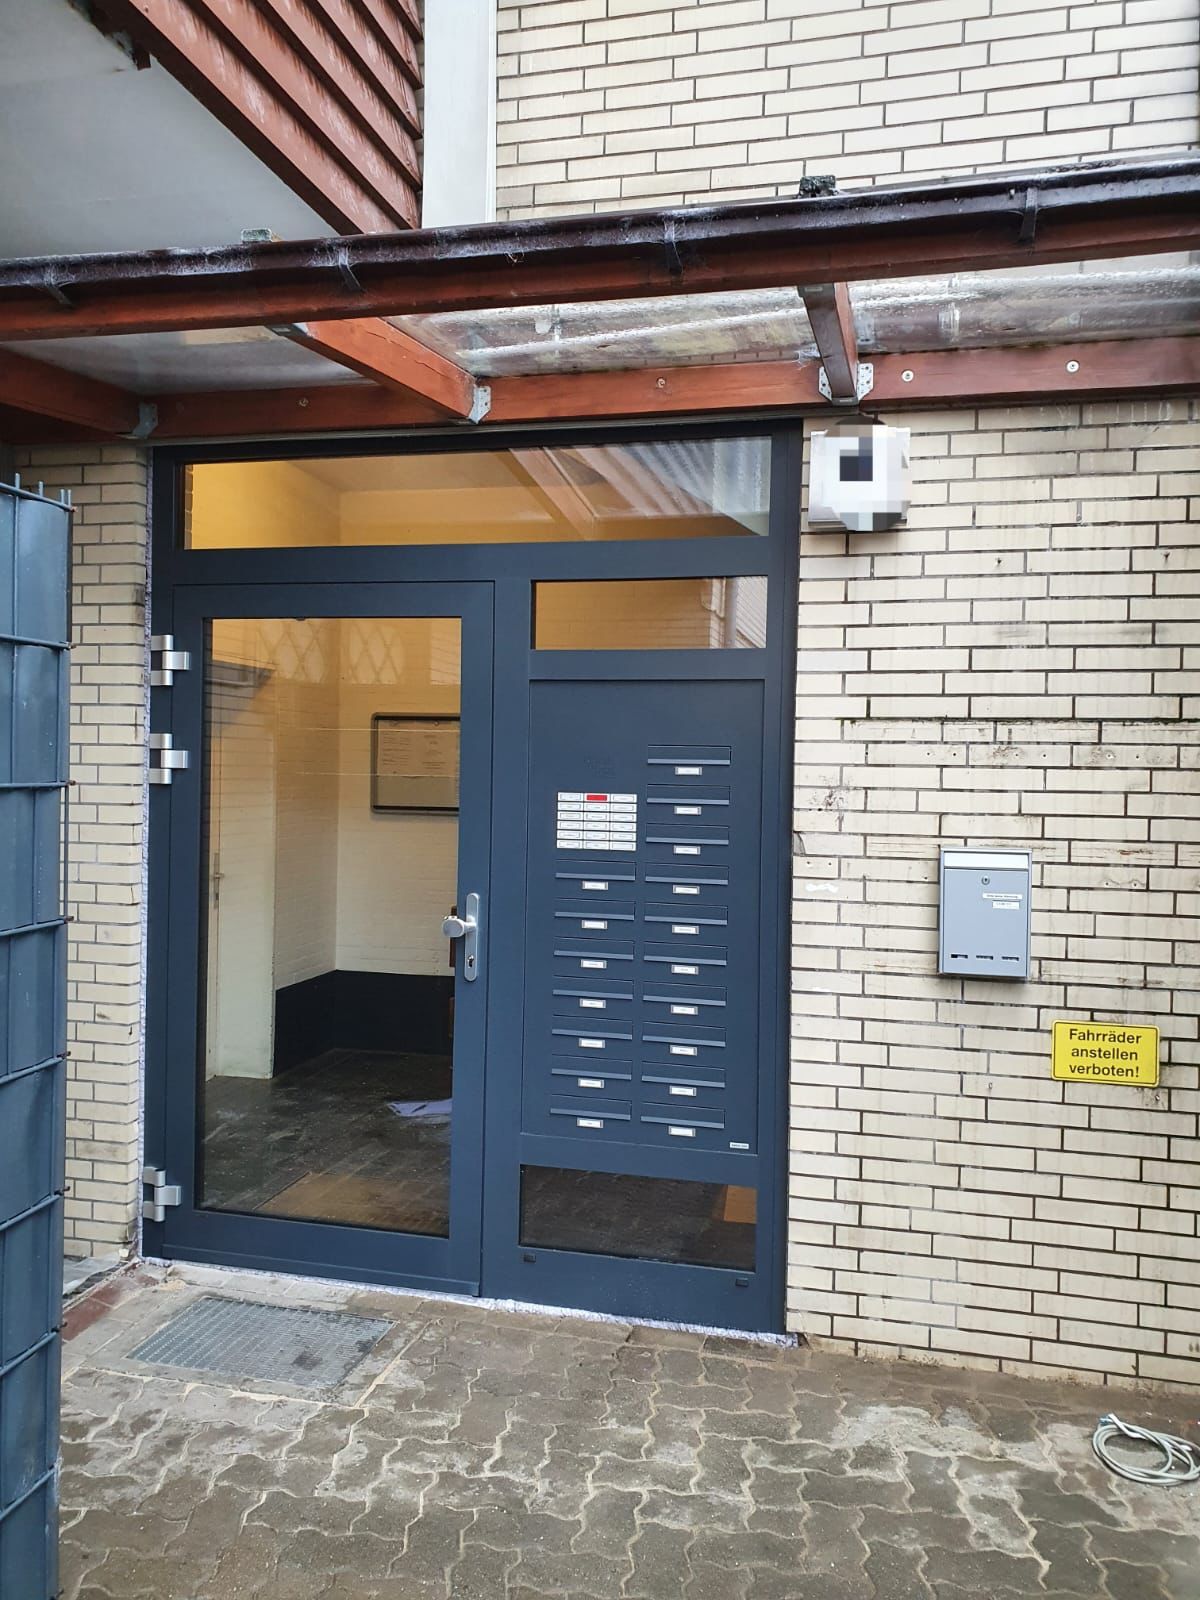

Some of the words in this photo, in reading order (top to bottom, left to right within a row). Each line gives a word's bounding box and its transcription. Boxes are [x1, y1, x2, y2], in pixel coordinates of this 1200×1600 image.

[1069, 1028, 1142, 1044] Fahrräder
[1071, 1047, 1138, 1060] anstellen
[1069, 1063, 1139, 1078] verboten!
